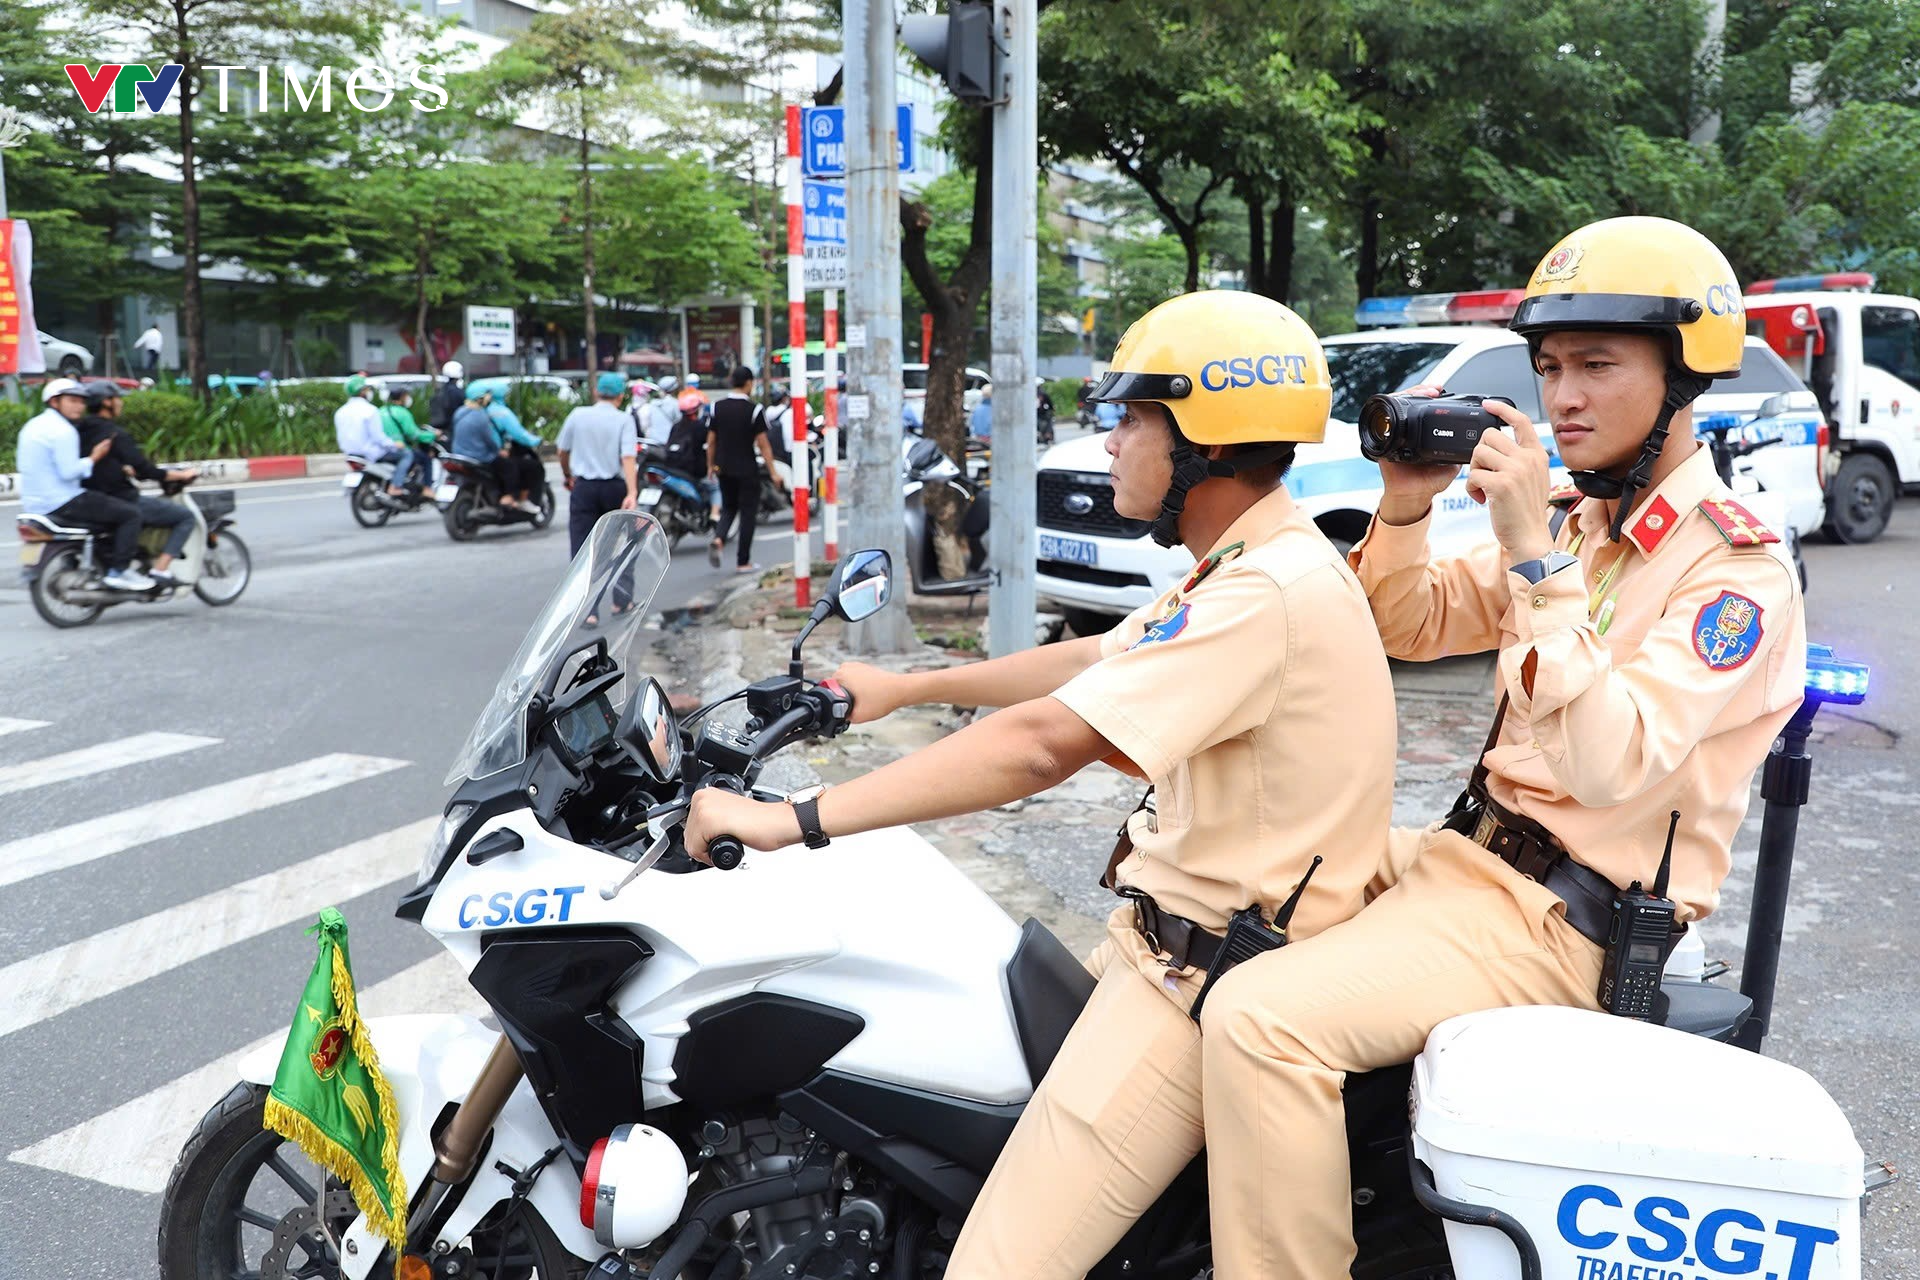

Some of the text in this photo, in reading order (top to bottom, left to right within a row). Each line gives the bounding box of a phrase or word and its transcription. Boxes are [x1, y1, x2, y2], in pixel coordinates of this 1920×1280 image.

[1200, 355, 1307, 392] CSGT
[1432, 428, 1454, 438] Canon
[1700, 626, 1748, 653] CSGT
[458, 885, 585, 929] C.S.G.T
